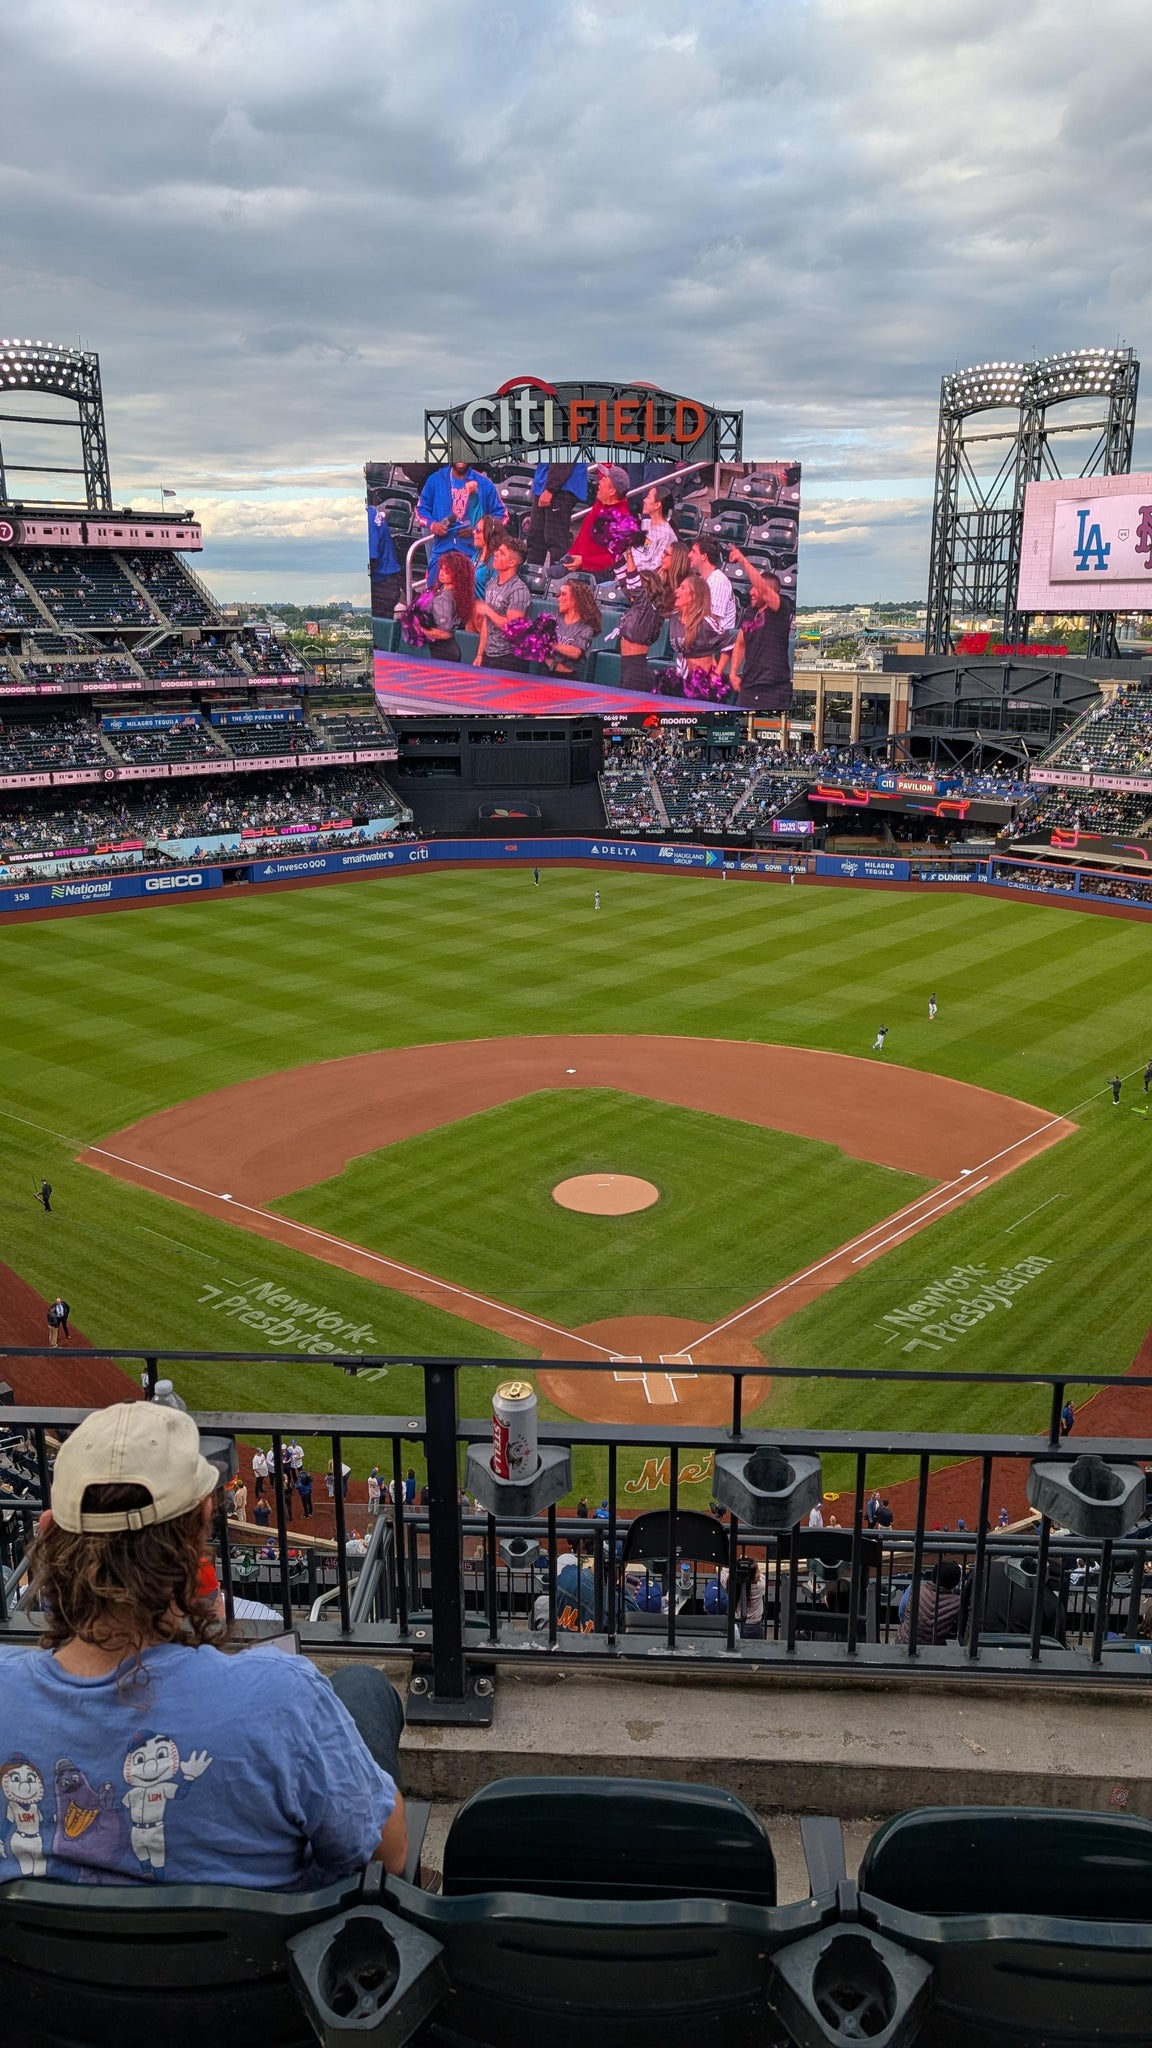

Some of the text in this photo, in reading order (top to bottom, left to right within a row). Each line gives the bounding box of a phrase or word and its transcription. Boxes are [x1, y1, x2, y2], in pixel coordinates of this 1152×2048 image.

[463, 388, 706, 442] citi FIELD
[0, 686, 36, 694] DODGERS
[660, 717, 697, 725] moomoo
[899, 782, 933, 791] PAVILION
[409, 848, 429, 861] citi
[602, 846, 637, 856] DELTA
[674, 852, 704, 860] HAUGLAND
[9, 853, 43, 861] WELCOME
[342, 851, 388, 865] smartwater
[277, 859, 326, 873] Invesco QQQ
[865, 868, 894, 876] TEQUILA
[938, 873, 971, 881] DUNKIN'
[145, 873, 203, 891] GEICO
[977, 874, 987, 883] 370
[65, 881, 112, 896] National
[1008, 881, 1048, 893] CADILLAC
[14, 893, 30, 902] 358
[919, 1255, 1054, 1343] Presbyterian
[494, 1423, 502, 1474] STELLA
[148, 1793, 162, 1802] LGM
[18, 1813, 35, 1823] LGM
